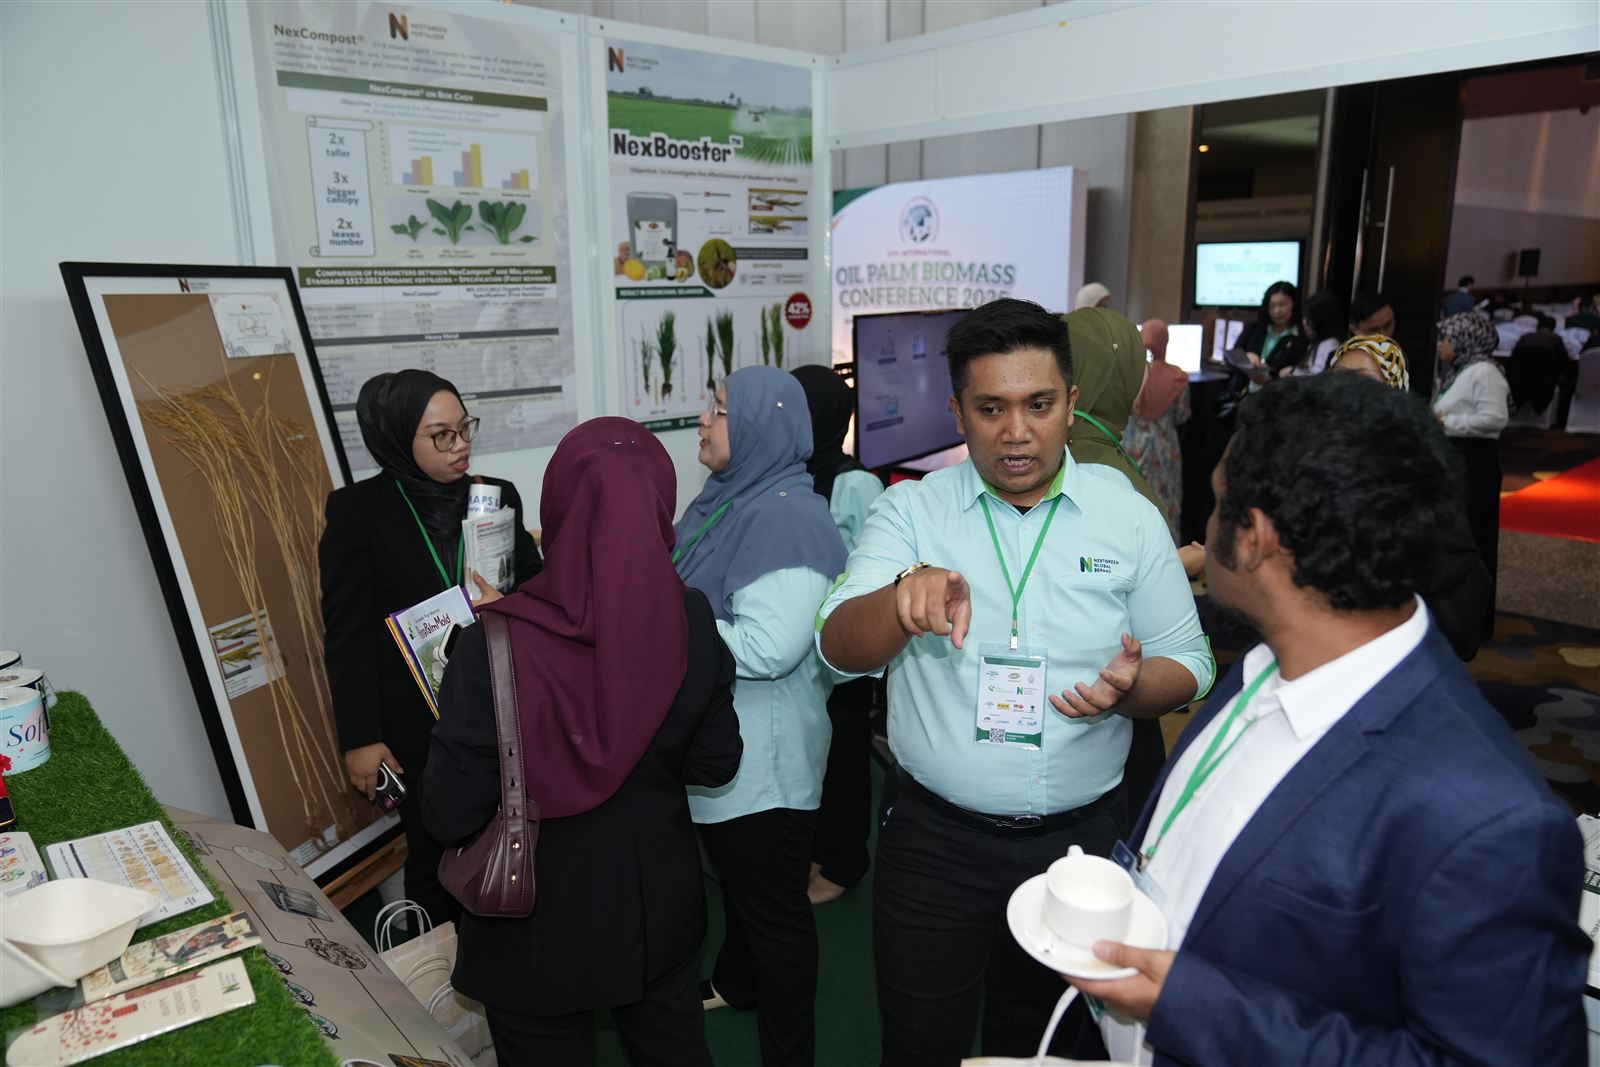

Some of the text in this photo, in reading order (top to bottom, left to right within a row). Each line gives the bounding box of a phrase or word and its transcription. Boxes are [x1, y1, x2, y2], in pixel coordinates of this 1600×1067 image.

[388, 12, 409, 41] N
[608, 46, 624, 73] N
[329, 133, 345, 145] 2x
[326, 149, 350, 158] taller
[332, 171, 349, 184] 3x
[327, 187, 357, 198] bigger
[326, 195, 359, 205] canopy
[337, 218, 353, 230] 2x
[332, 230, 360, 238] leaves
[329, 238, 364, 246] number
[835, 262, 1015, 286] OIL PALM BIOMASS
[839, 286, 959, 308] CONFERENCE
[788, 303, 809, 315] 42%
